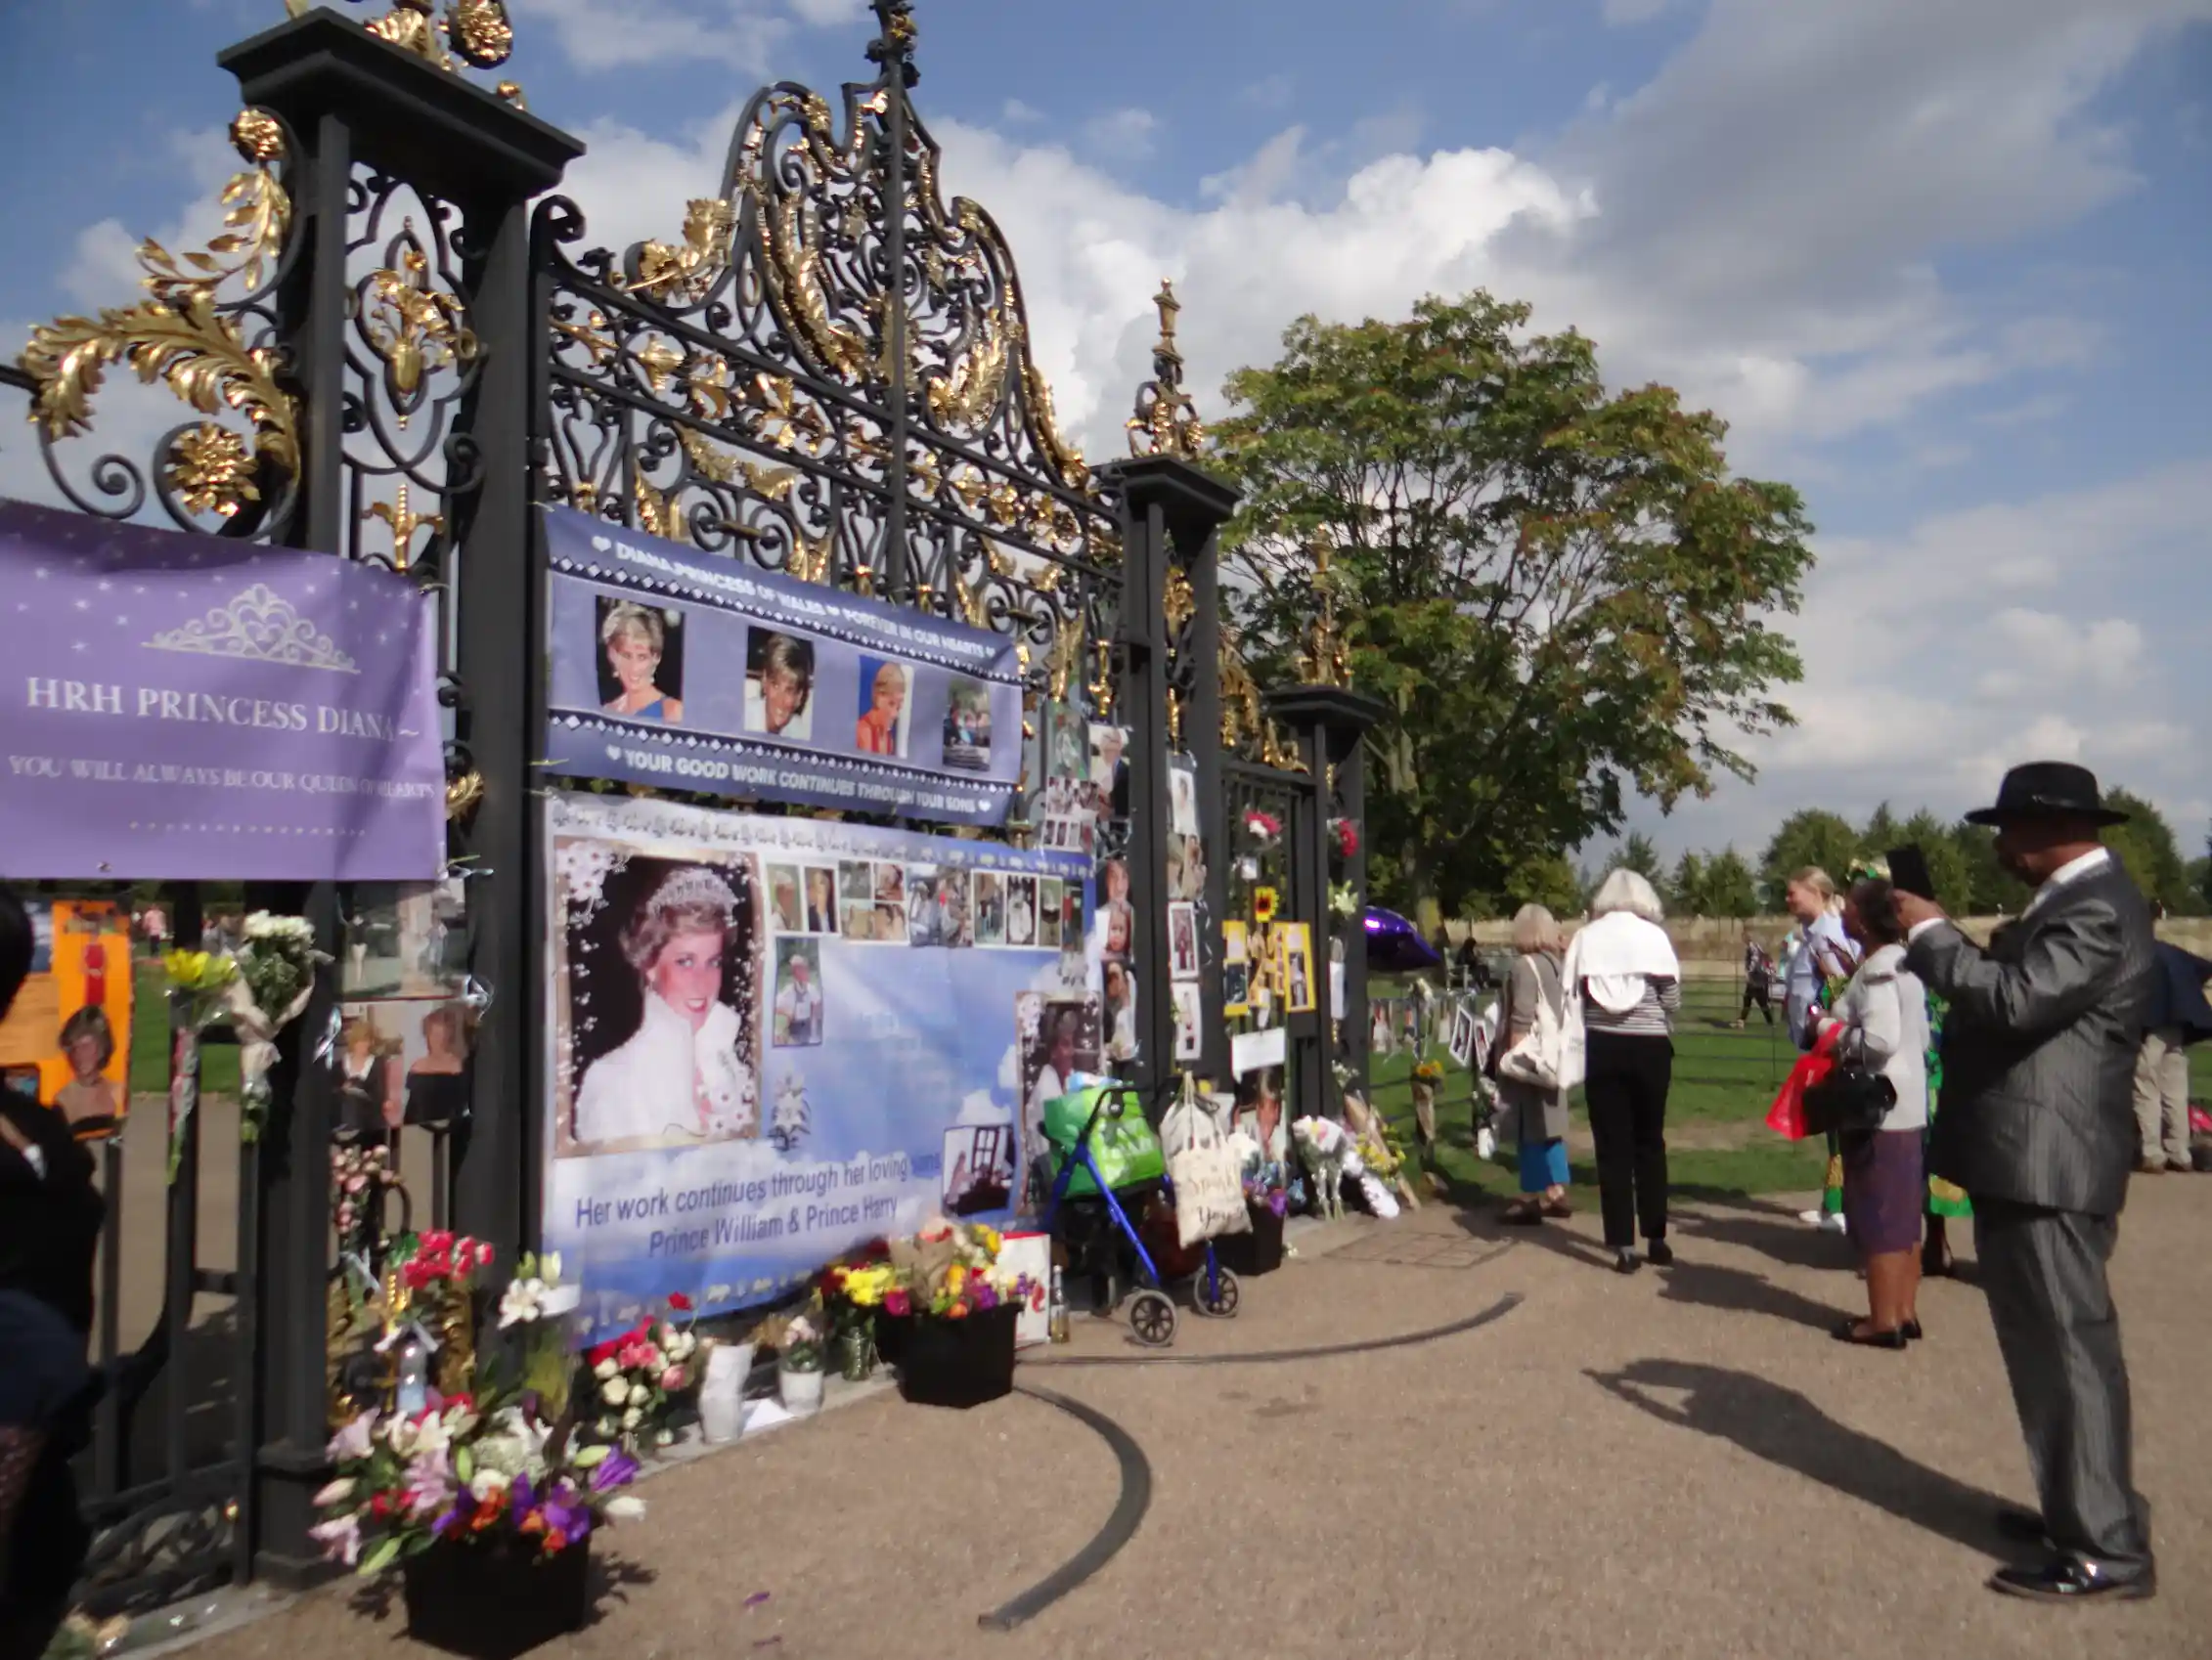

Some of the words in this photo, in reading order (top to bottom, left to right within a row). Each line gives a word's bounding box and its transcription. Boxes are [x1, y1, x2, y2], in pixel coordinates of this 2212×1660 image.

[27, 677, 123, 715] HRH
[137, 687, 307, 732] PRINCESS
[9, 755, 62, 778] YOU
[70, 759, 127, 781] WILL
[133, 764, 220, 786] ALWAYS
[251, 770, 295, 790] OUR
[625, 749, 673, 773] YOUR
[675, 754, 729, 778] GOOD
[732, 764, 777, 783] WORK
[779, 771, 856, 797] CONTINUES
[858, 782, 914, 805] THROUGH
[576, 1199, 610, 1229] Her
[617, 1188, 669, 1222] work
[676, 1179, 767, 1214] continues
[771, 1168, 838, 1199] through
[843, 1162, 866, 1187] her
[868, 1156, 908, 1184] loving
[649, 1228, 708, 1258] Prince
[715, 1214, 783, 1246] William
[786, 1208, 800, 1234] &
[806, 1203, 859, 1231] Prince
[863, 1194, 899, 1222] Harry
